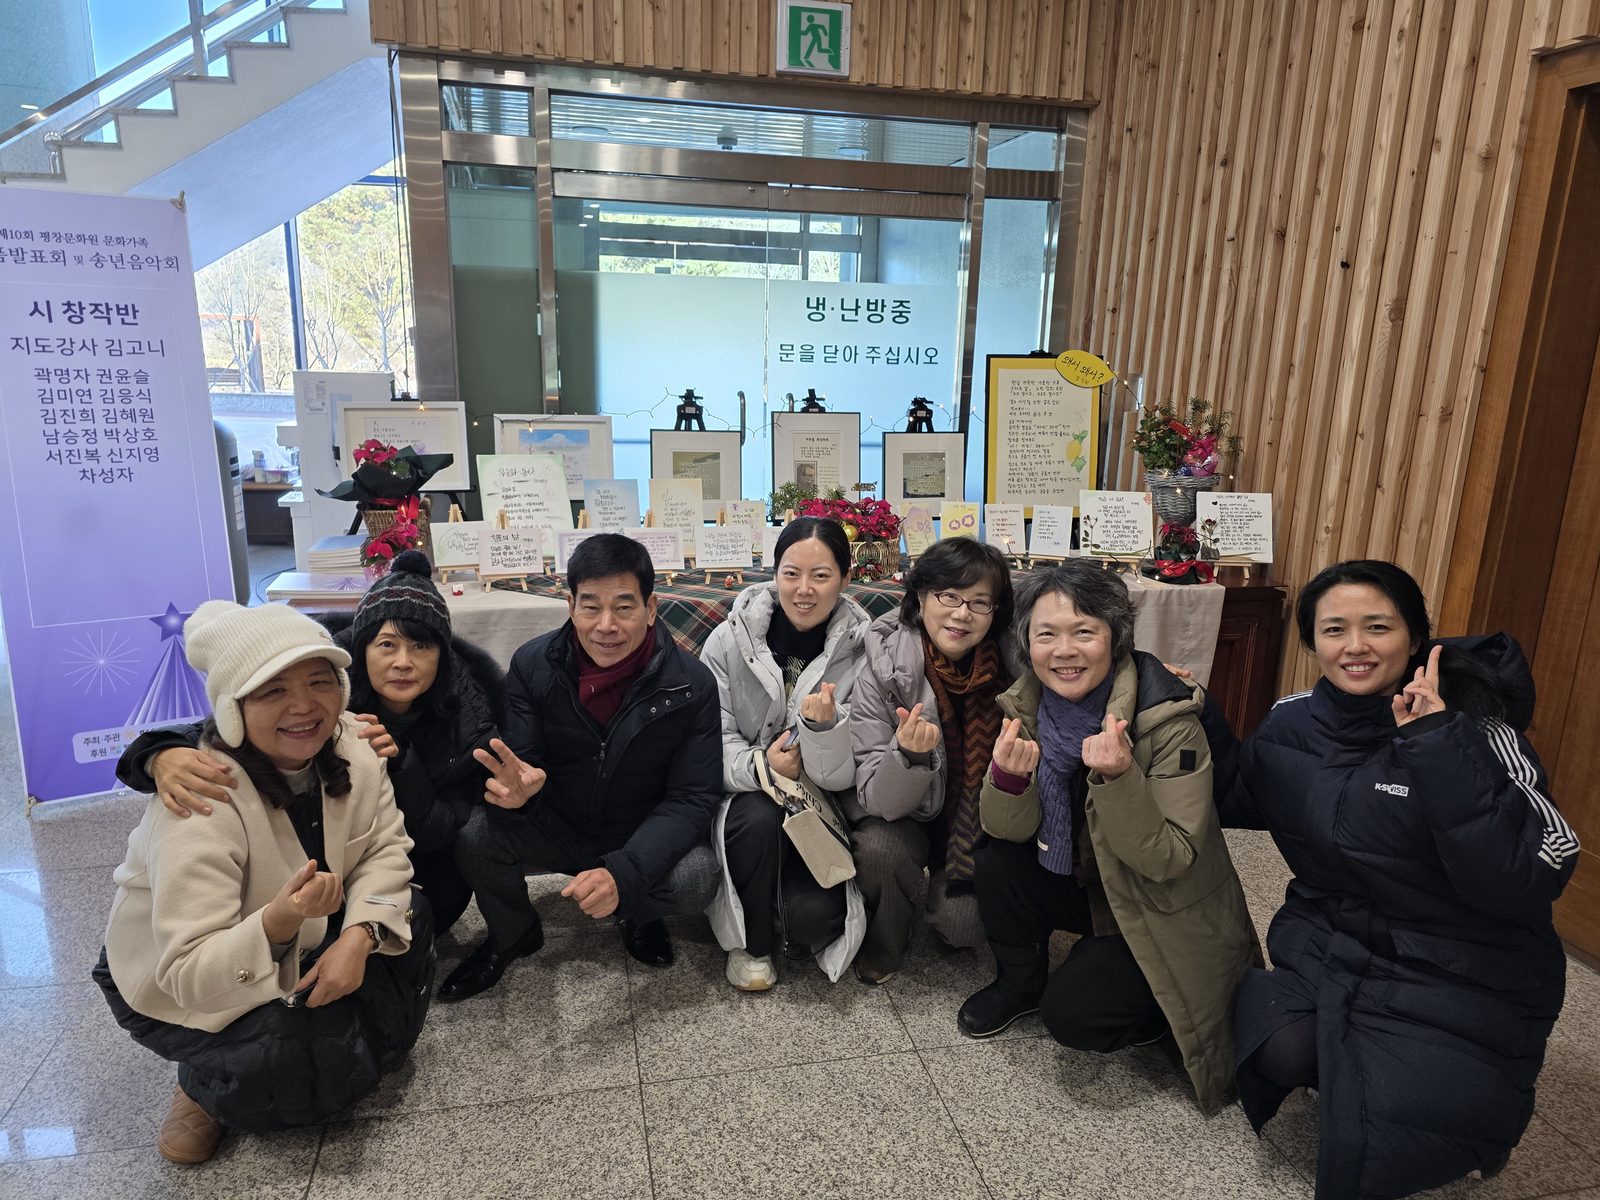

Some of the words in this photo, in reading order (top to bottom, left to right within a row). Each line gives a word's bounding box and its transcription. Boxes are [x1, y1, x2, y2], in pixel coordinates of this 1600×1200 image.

[0, 228, 34, 242] 제10회
[39, 231, 99, 246] 평창문화원
[102, 235, 150, 249] 문화가족
[73, 255, 84, 266] 및
[89, 251, 180, 272] 송년음악회
[28, 300, 53, 324] 시
[61, 300, 140, 326] 창작반
[10, 336, 98, 357] 지도강사
[104, 338, 166, 358] 김고니
[778, 343, 816, 363] 문을
[823, 345, 859, 364] 닫아
[865, 346, 939, 366] 주십시오
[1061, 356, 1081, 371] 왜서
[33, 367, 90, 385] 곽명자
[96, 368, 151, 385] 권윤슬
[37, 388, 94, 405] 김미연
[98, 388, 153, 405] 김응식
[40, 408, 96, 425] 김진희
[101, 408, 155, 424] 김혜원
[42, 428, 98, 446] 남승정
[103, 427, 159, 443] 박상호
[45, 448, 102, 465] 서진복
[107, 447, 160, 464] 신지영
[78, 467, 134, 484] 차성자
[90, 748, 108, 758] 후원
